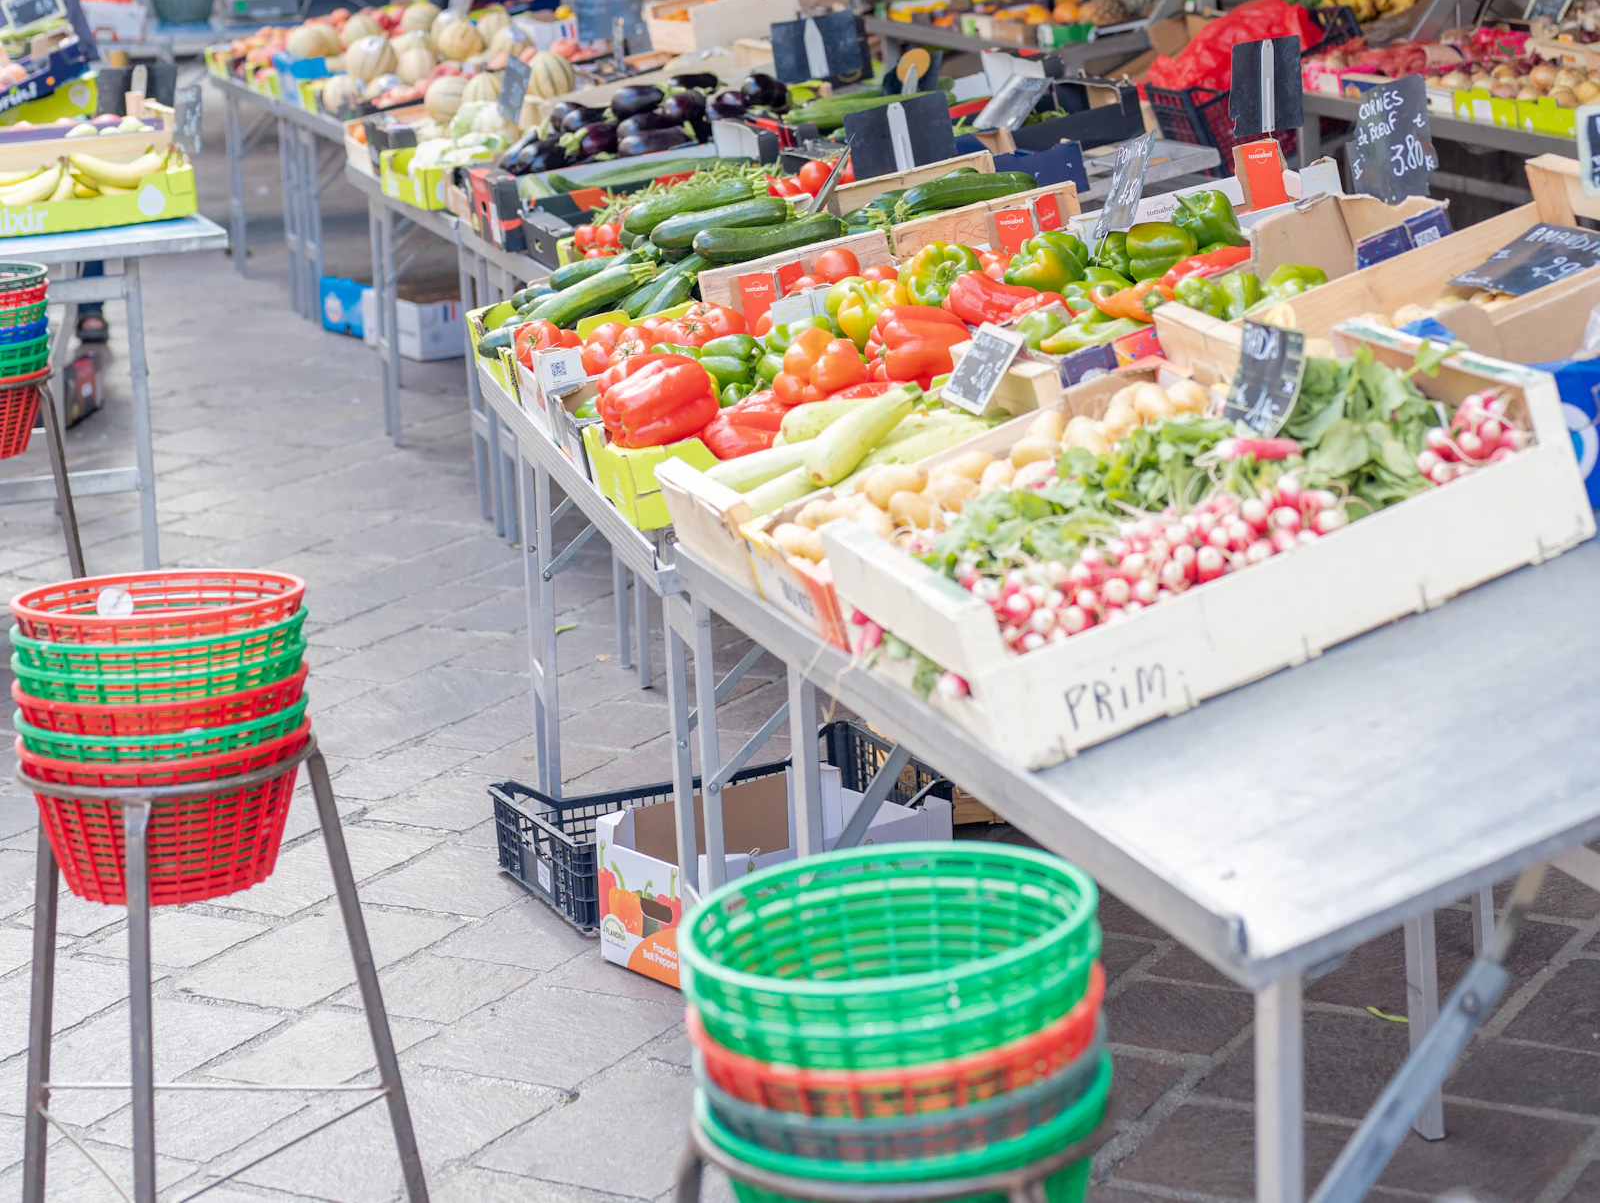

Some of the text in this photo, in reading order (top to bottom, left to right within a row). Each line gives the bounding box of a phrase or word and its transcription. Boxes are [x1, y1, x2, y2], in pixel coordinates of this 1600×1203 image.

[1359, 90, 1404, 120] CORNES
[1248, 151, 1273, 160] tomabel
[1146, 204, 1176, 217] tomabel
[1000, 216, 1025, 226] tomabel
[745, 284, 769, 293] tomabel
[653, 941, 677, 960] Paprika
[642, 948, 678, 971] Bell Pepper
